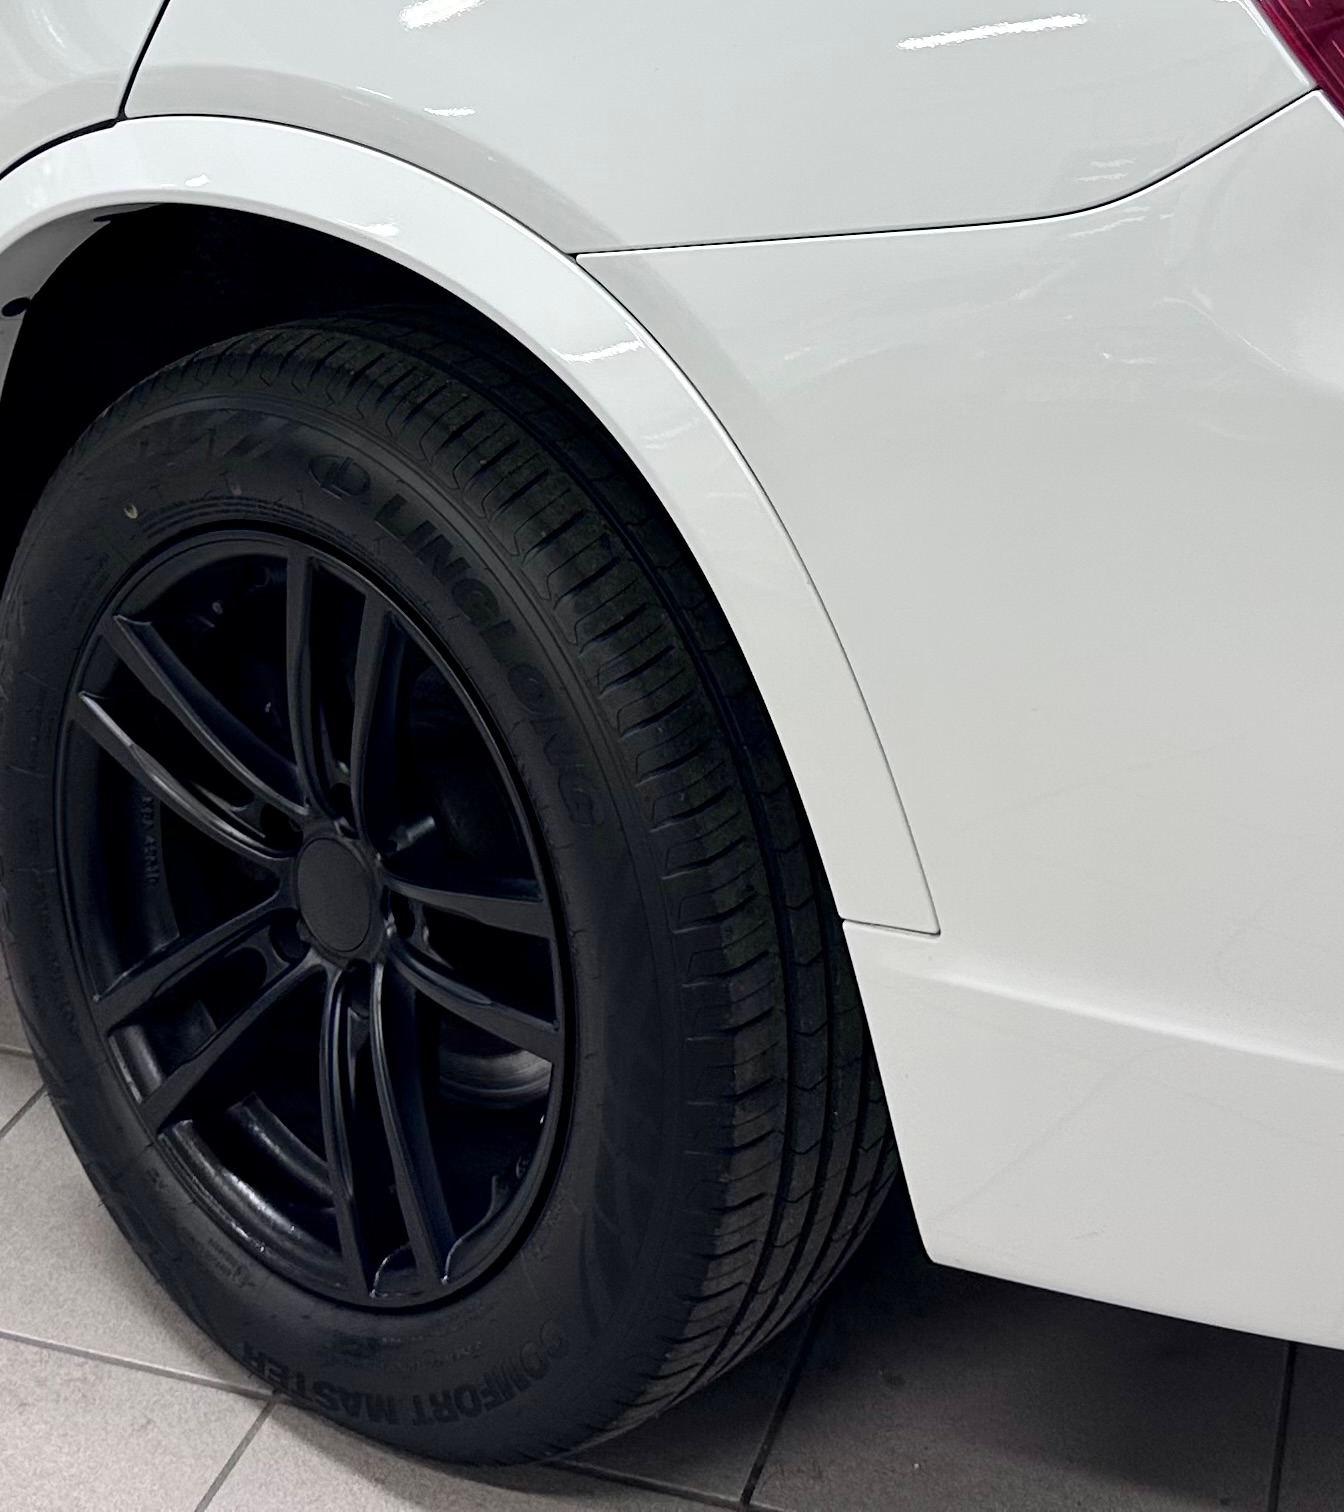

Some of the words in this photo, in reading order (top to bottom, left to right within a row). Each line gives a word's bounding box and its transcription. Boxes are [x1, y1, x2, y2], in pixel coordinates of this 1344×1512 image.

[374, 493, 595, 826] LINGLONG
[243, 1341, 399, 1426] MASTER
[411, 1320, 569, 1426] COMFORT
